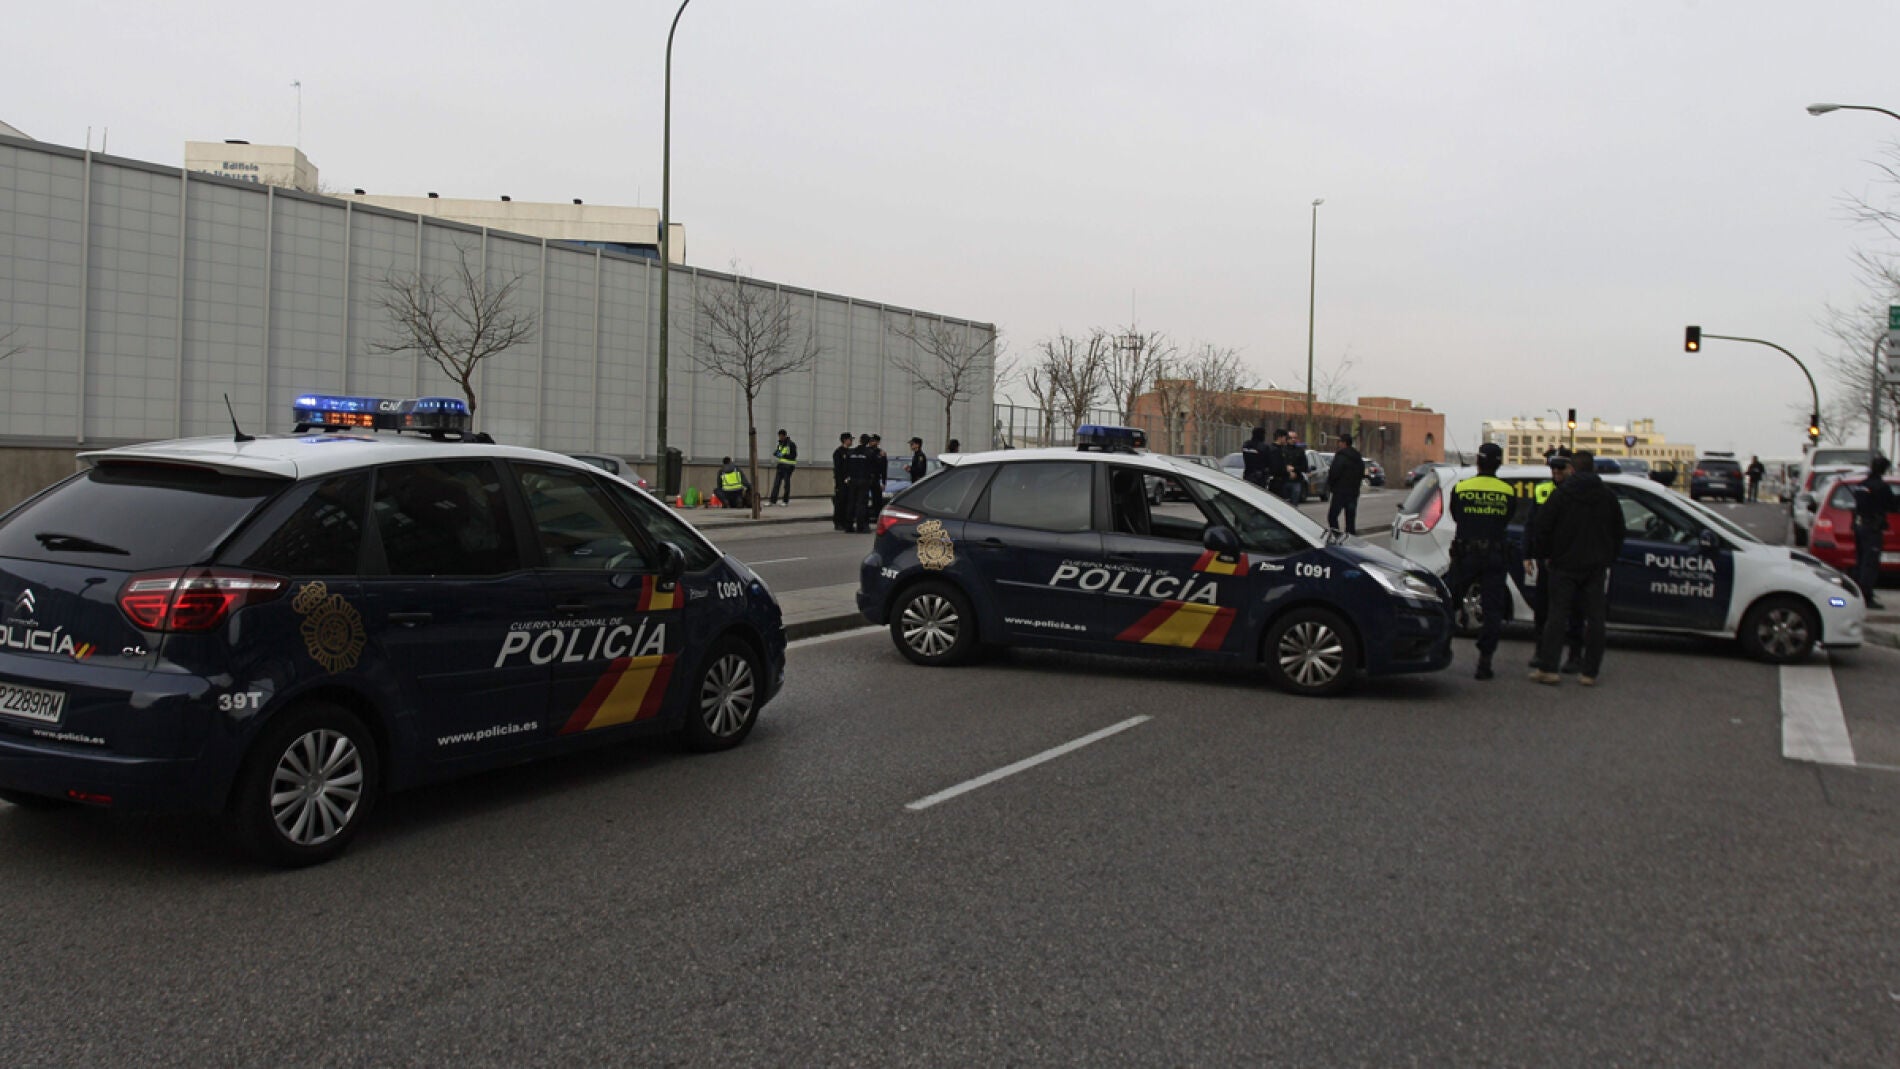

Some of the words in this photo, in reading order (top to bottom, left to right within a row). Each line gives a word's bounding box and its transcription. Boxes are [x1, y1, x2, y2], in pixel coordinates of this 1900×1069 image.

[1049, 564, 1218, 605] POLICÍA
[1650, 581, 1715, 598] madrid
[510, 620, 555, 631] CUERPO
[557, 618, 607, 629] NACIONAL
[609, 617, 624, 625] DE
[1004, 617, 1087, 631] www.policia.es
[494, 616, 666, 668] POLICÍA
[219, 691, 262, 711] 39T
[33, 728, 106, 745] www.policia.es
[438, 721, 538, 745] www.policia.es
